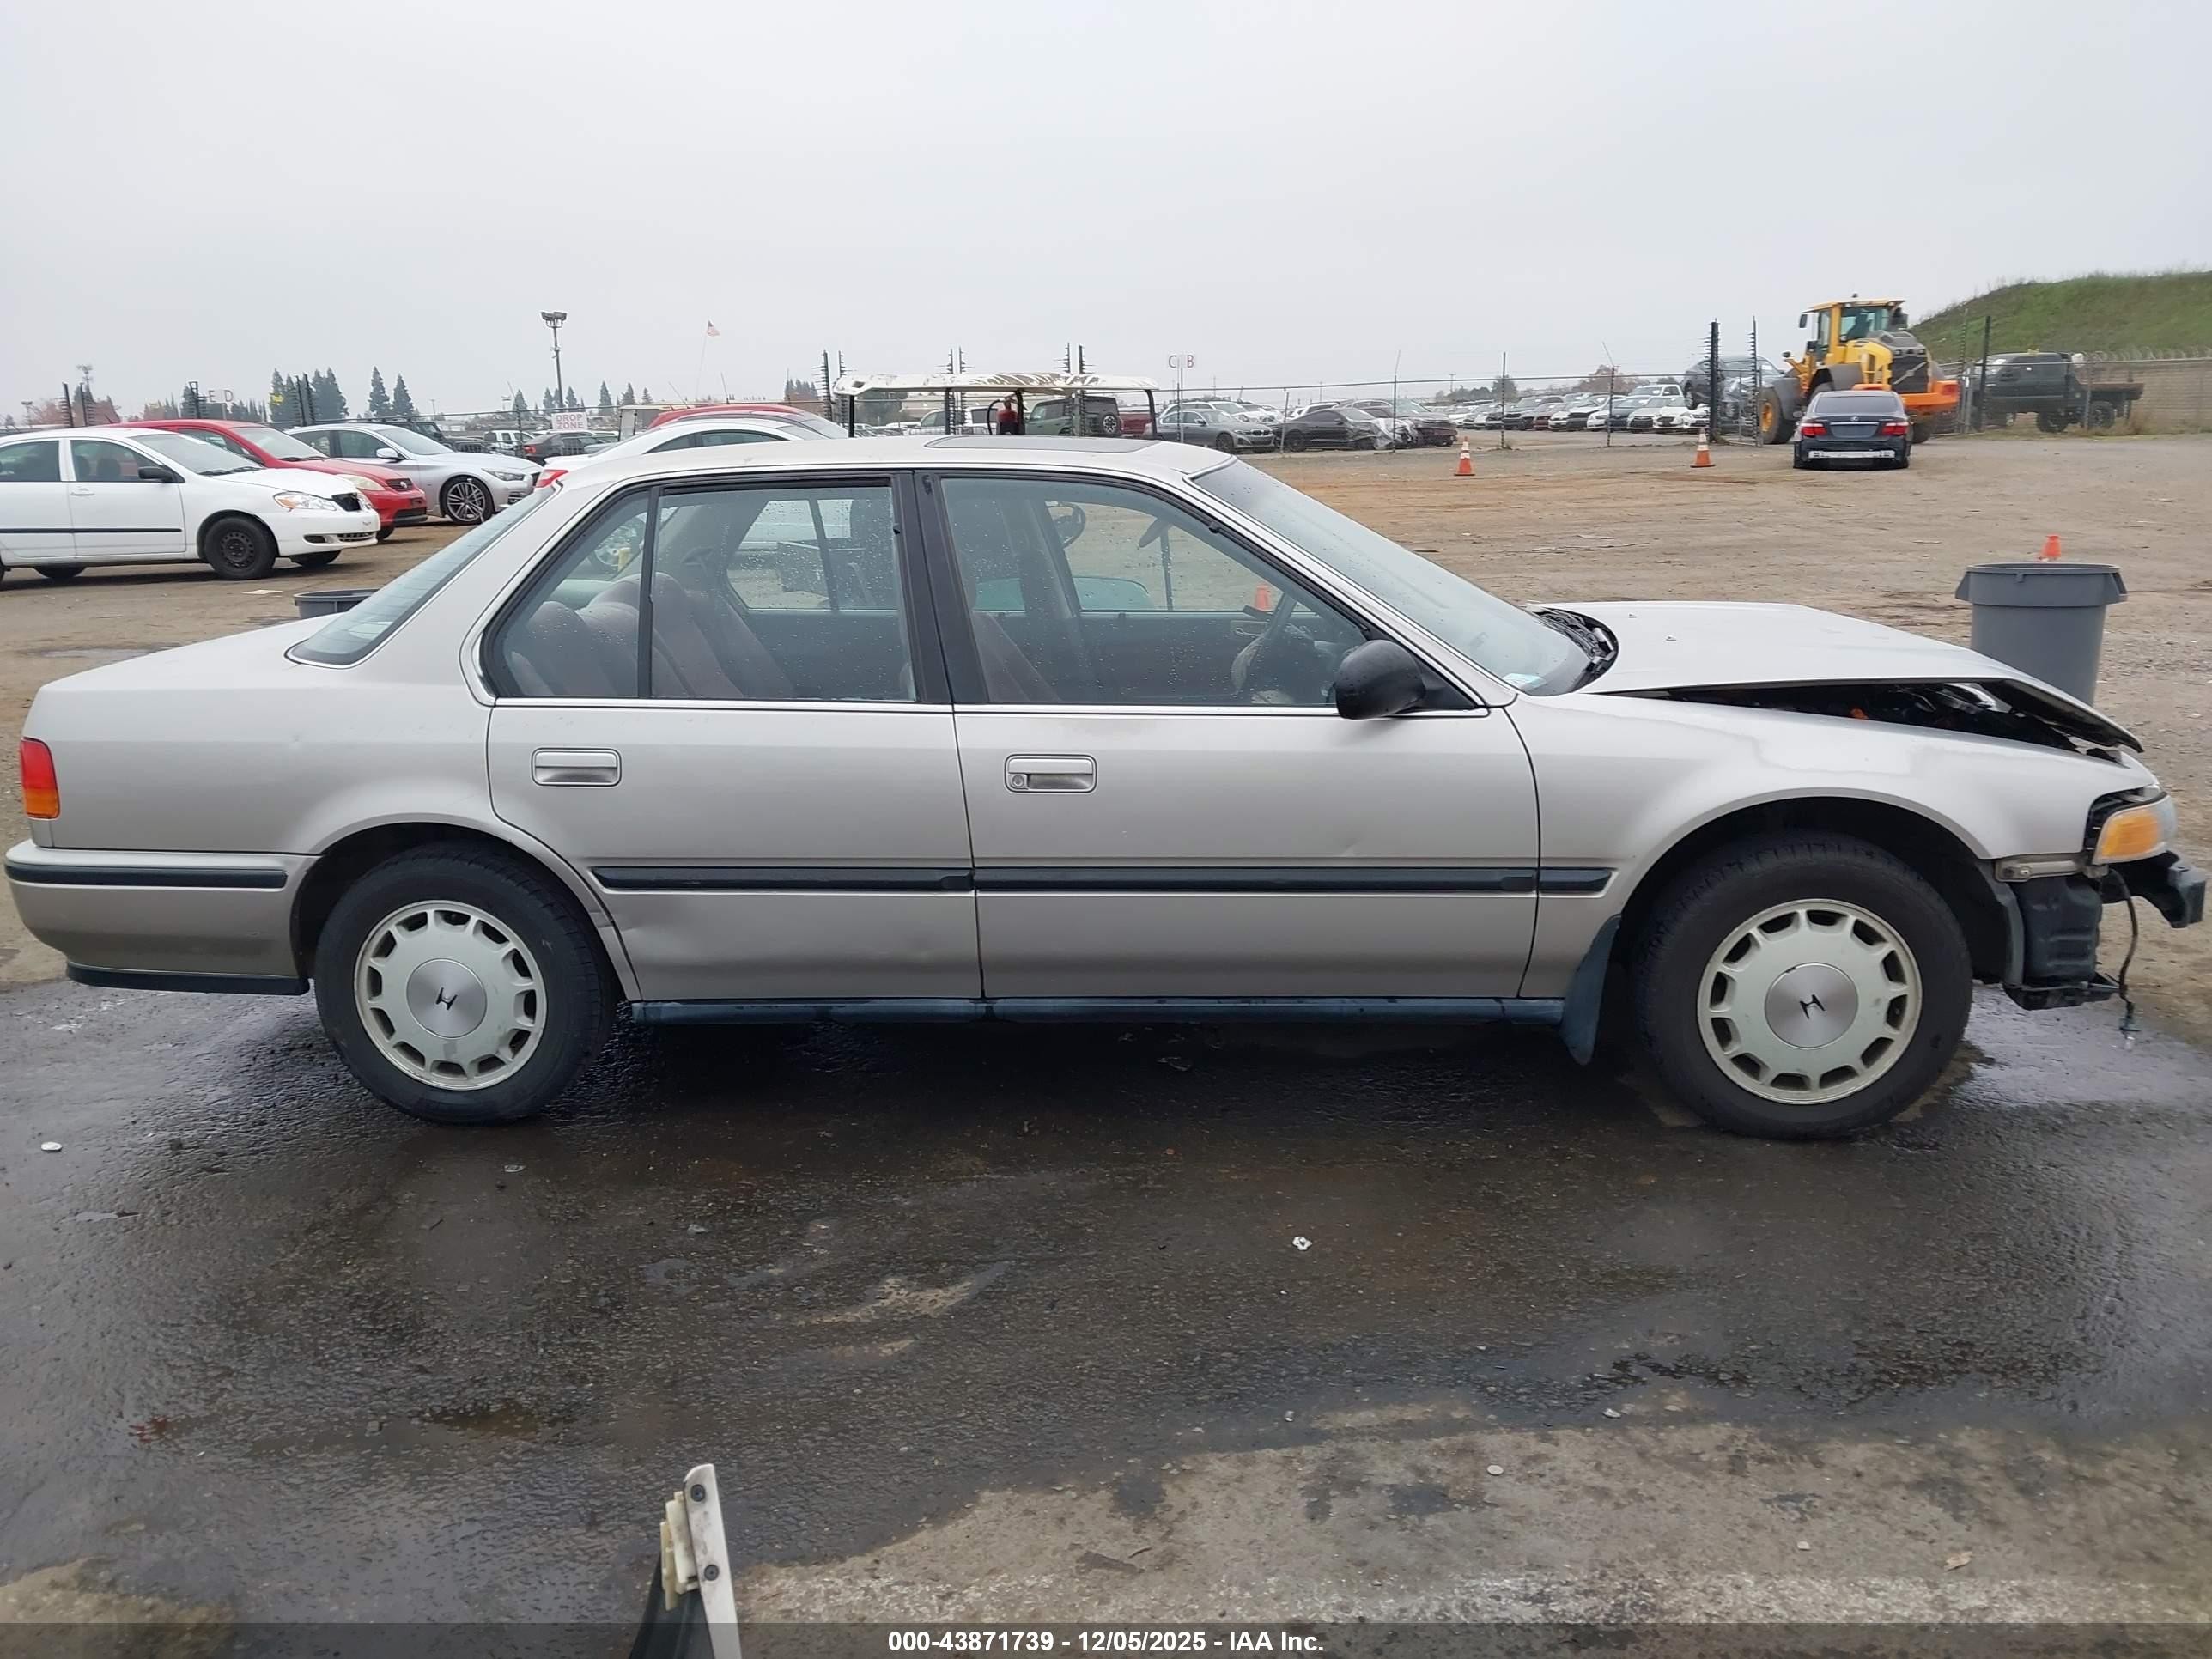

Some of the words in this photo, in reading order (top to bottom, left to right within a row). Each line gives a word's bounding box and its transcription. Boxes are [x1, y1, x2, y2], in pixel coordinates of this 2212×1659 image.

[1187, 354, 1195, 368] B
[208, 389, 216, 403] E
[224, 389, 234, 403] D
[556, 413, 583, 422] DROP
[556, 421, 585, 429] ZONE
